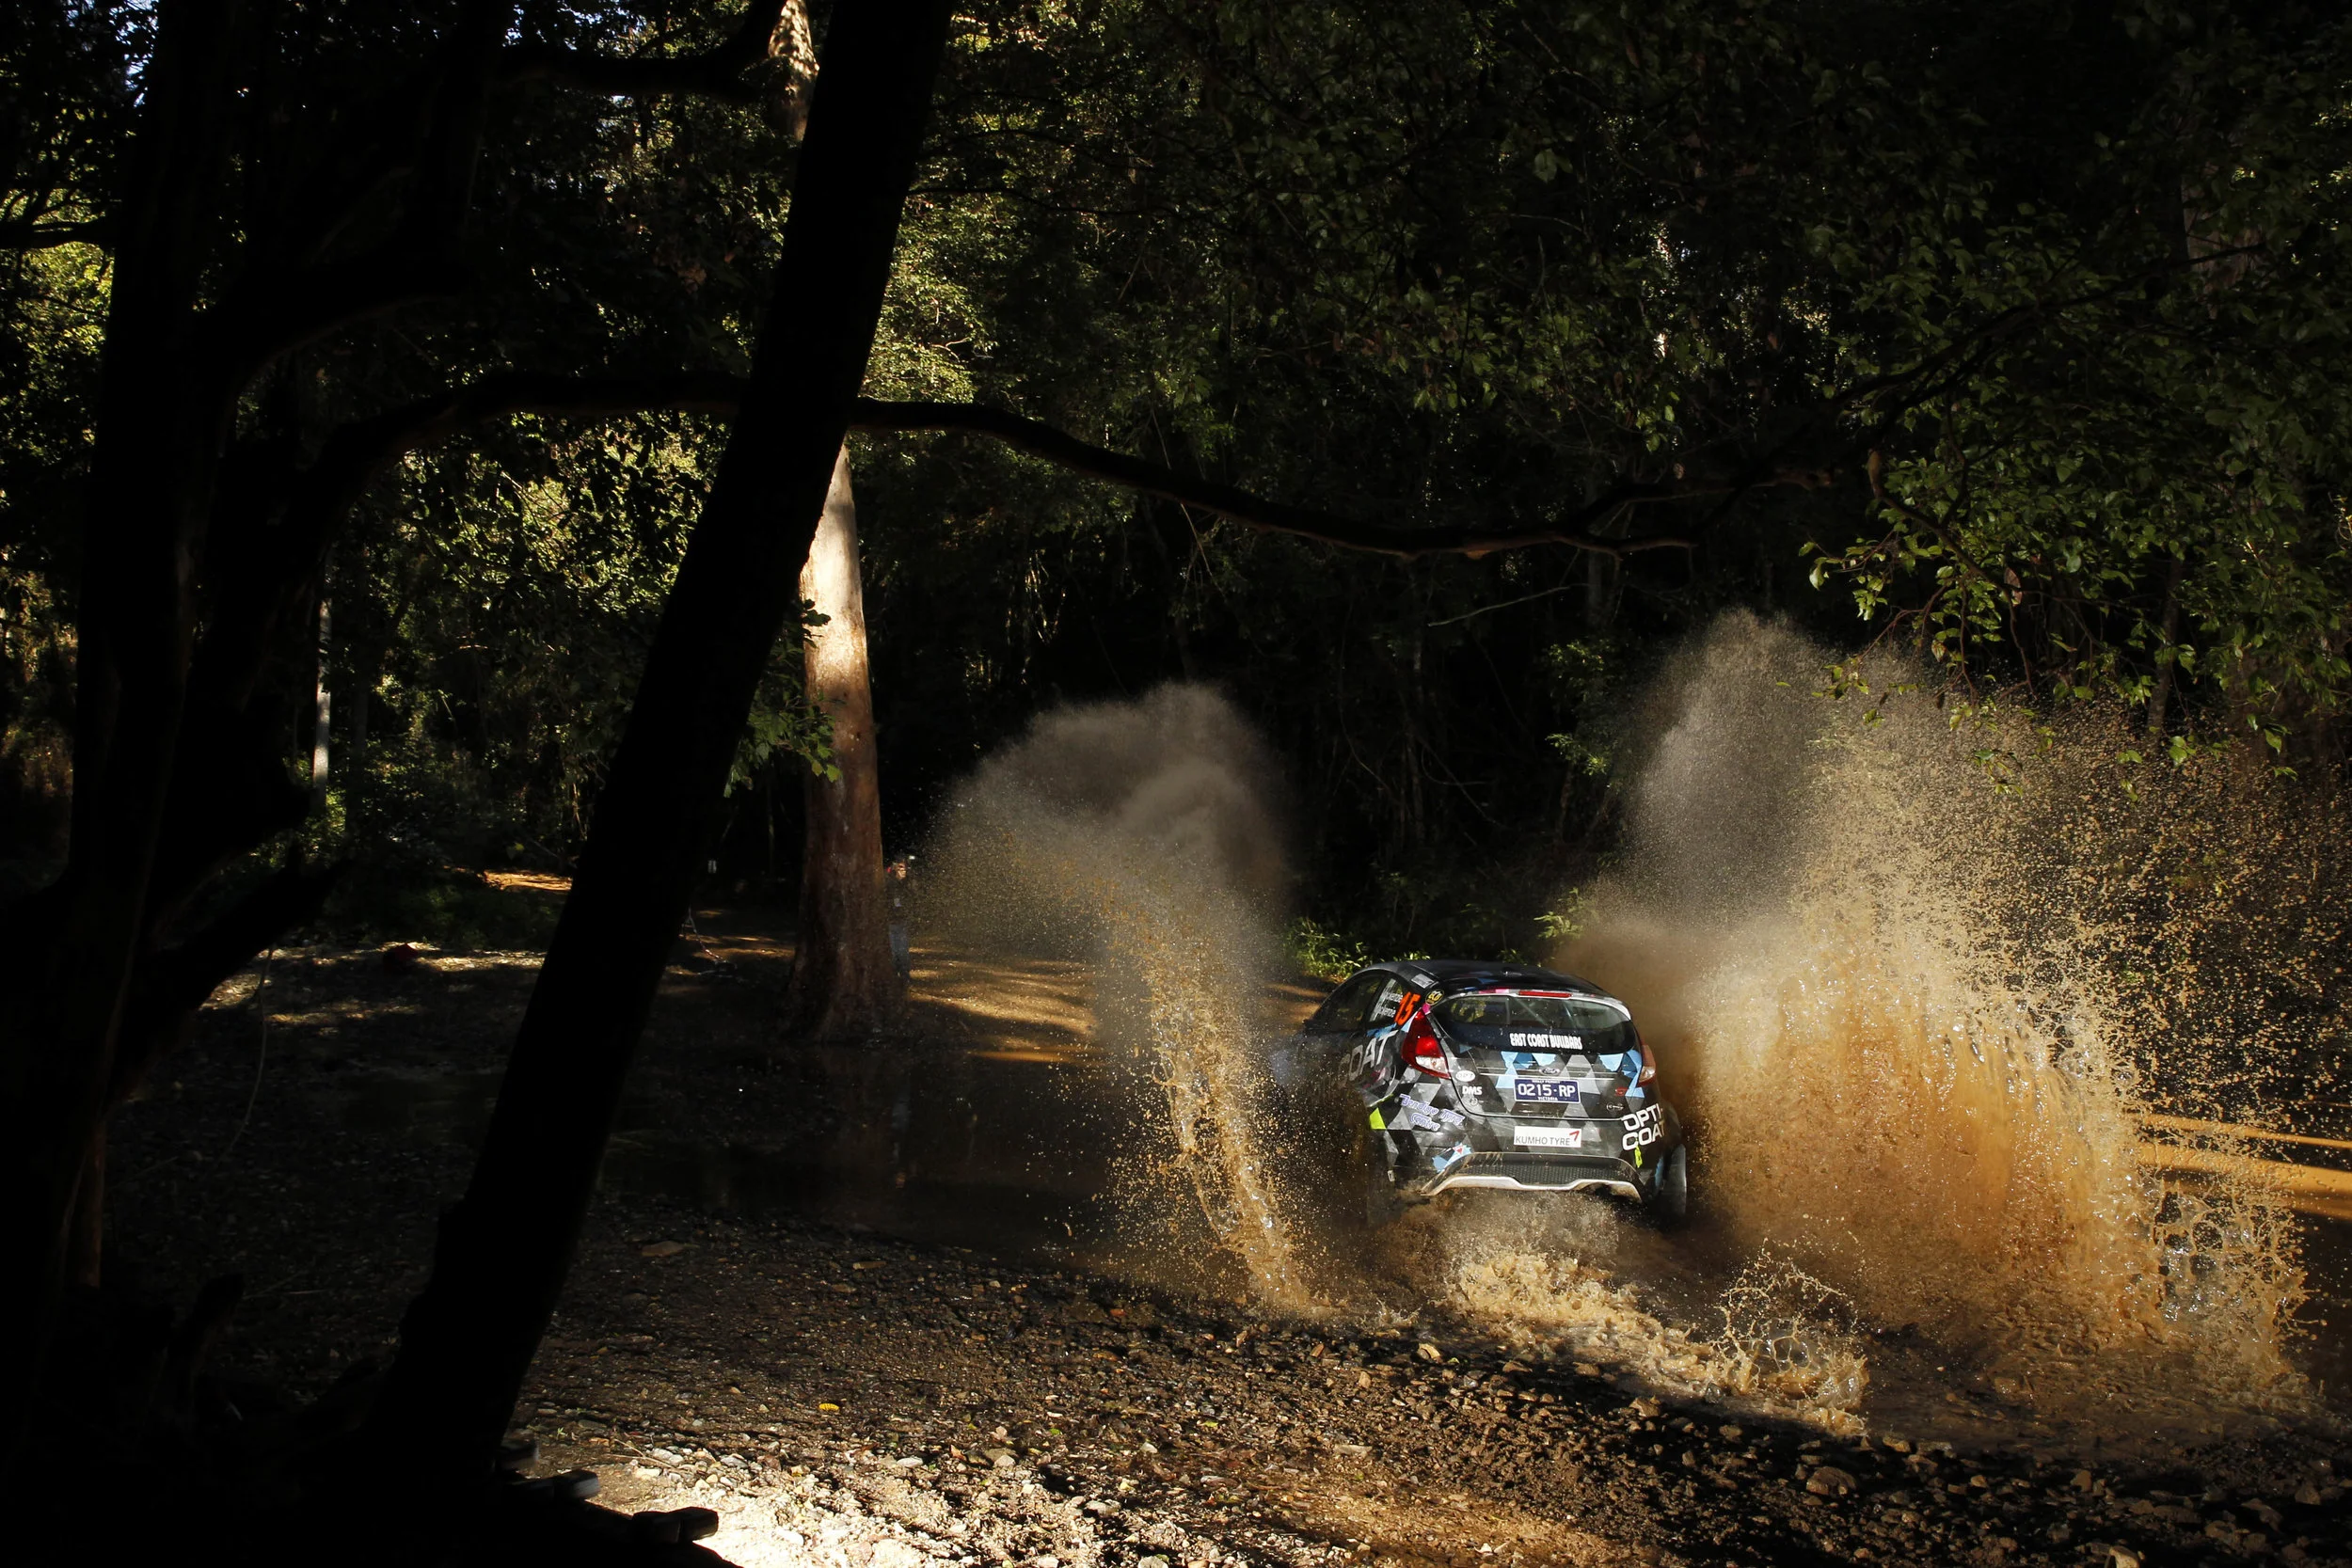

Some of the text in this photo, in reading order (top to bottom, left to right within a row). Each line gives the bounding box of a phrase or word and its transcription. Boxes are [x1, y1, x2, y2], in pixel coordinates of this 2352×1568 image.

[1394, 991, 1421, 1025] 15
[1509, 1033, 1582, 1050] EAST COAST BULLBARS
[1462, 1086, 1483, 1096] DMS
[1399, 1093, 1439, 1116] Bendigo
[1516, 1135, 1570, 1146] KUMHO TYRE
[1622, 1120, 1665, 1151] COAT
